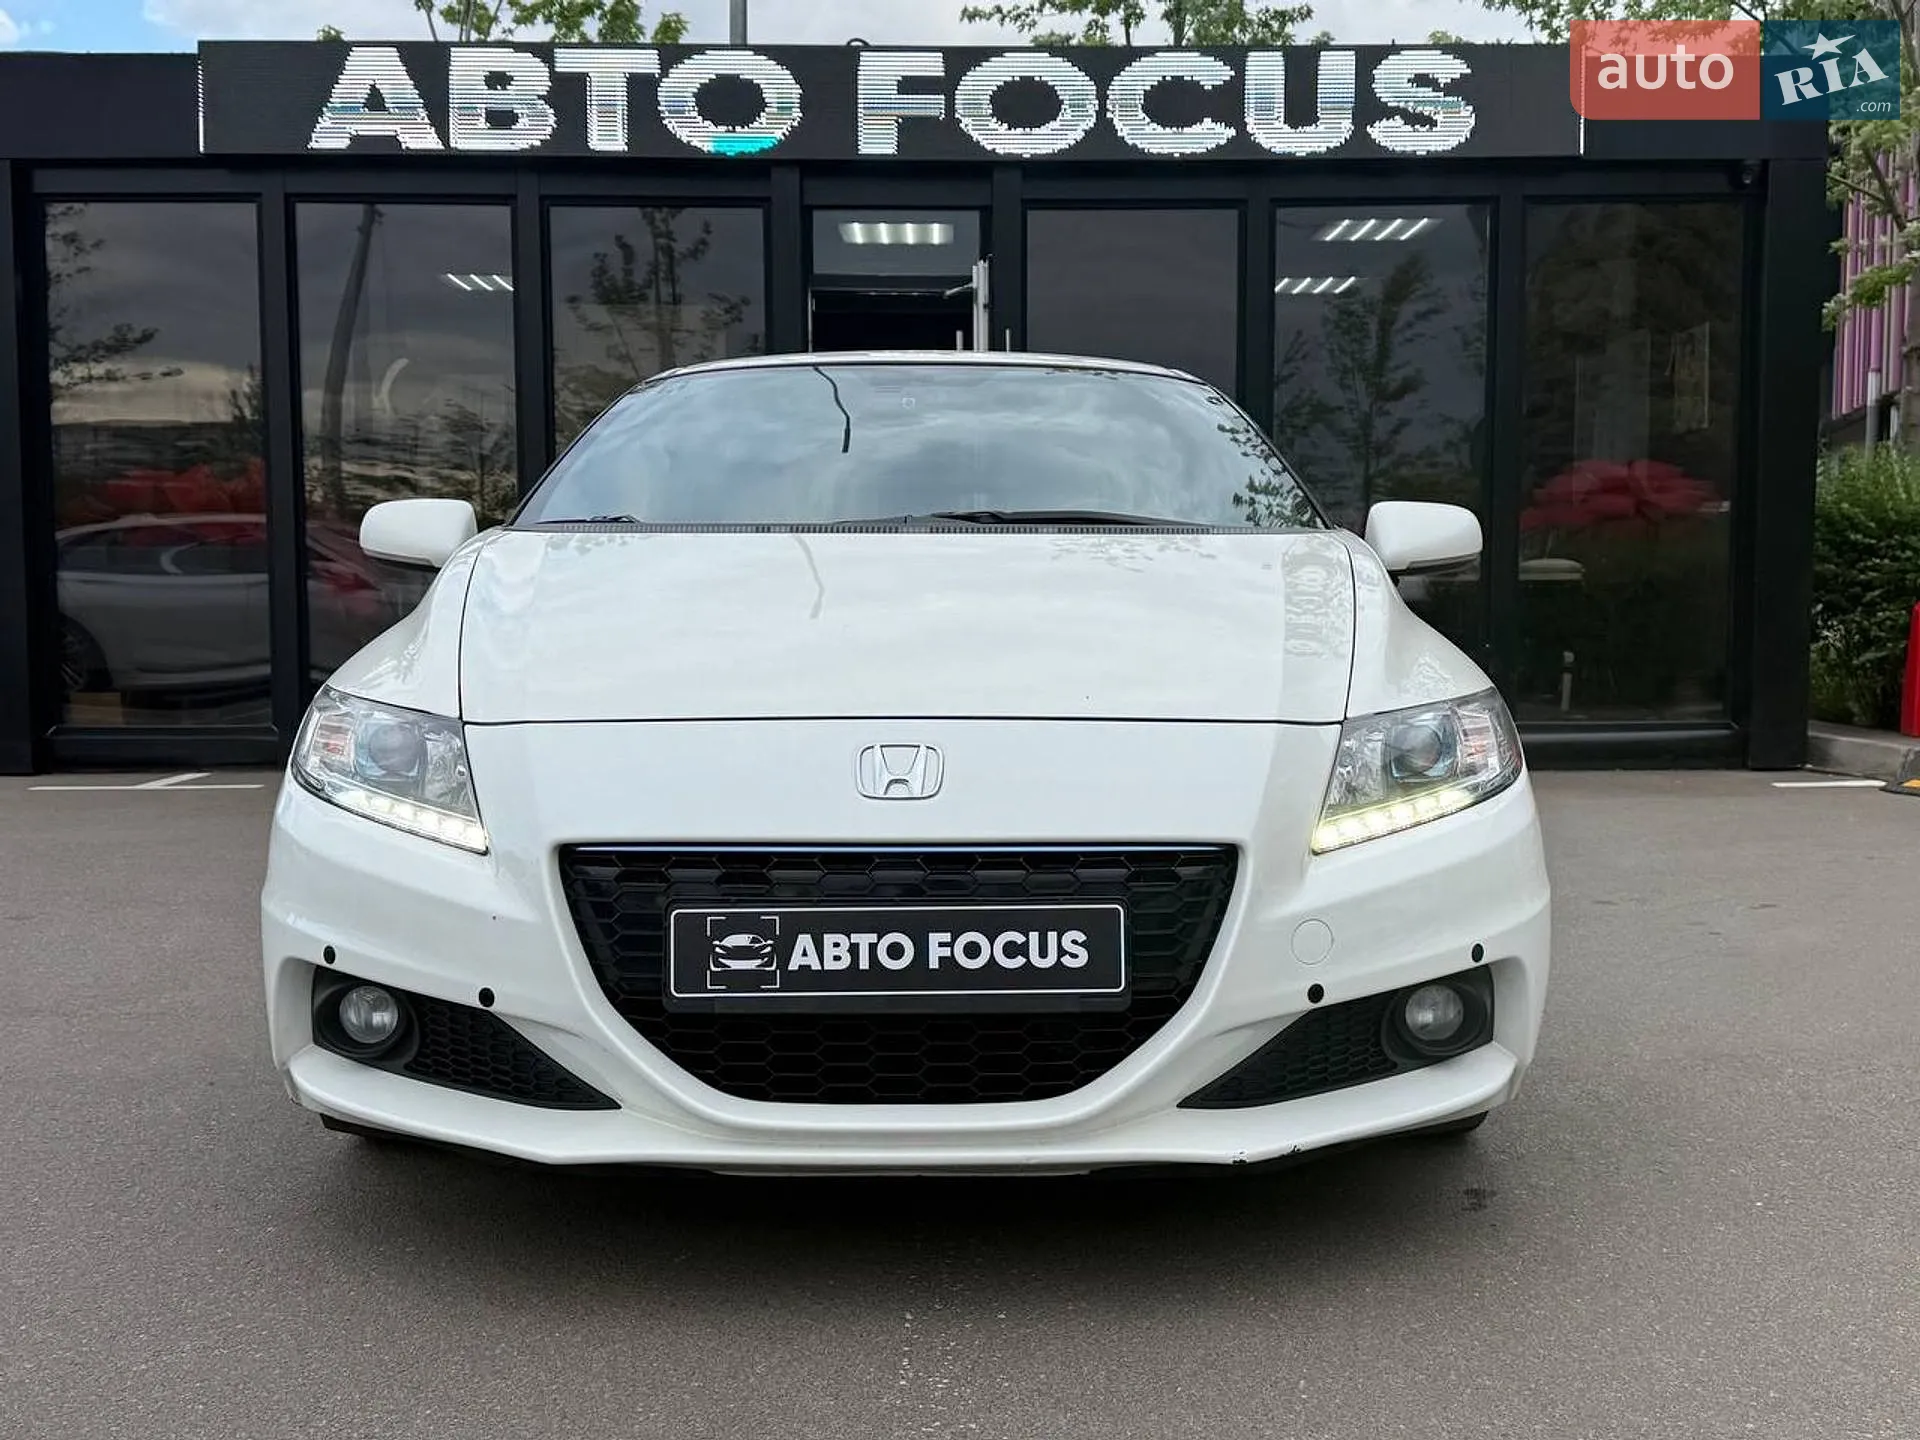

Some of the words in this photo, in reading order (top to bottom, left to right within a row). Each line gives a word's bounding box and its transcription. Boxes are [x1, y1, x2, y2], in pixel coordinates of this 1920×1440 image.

[306, 46, 803, 156] АВТО
[857, 49, 1475, 158] FOCUS
[787, 931, 914, 971] АВТО
[928, 930, 1089, 970] FOCUS
